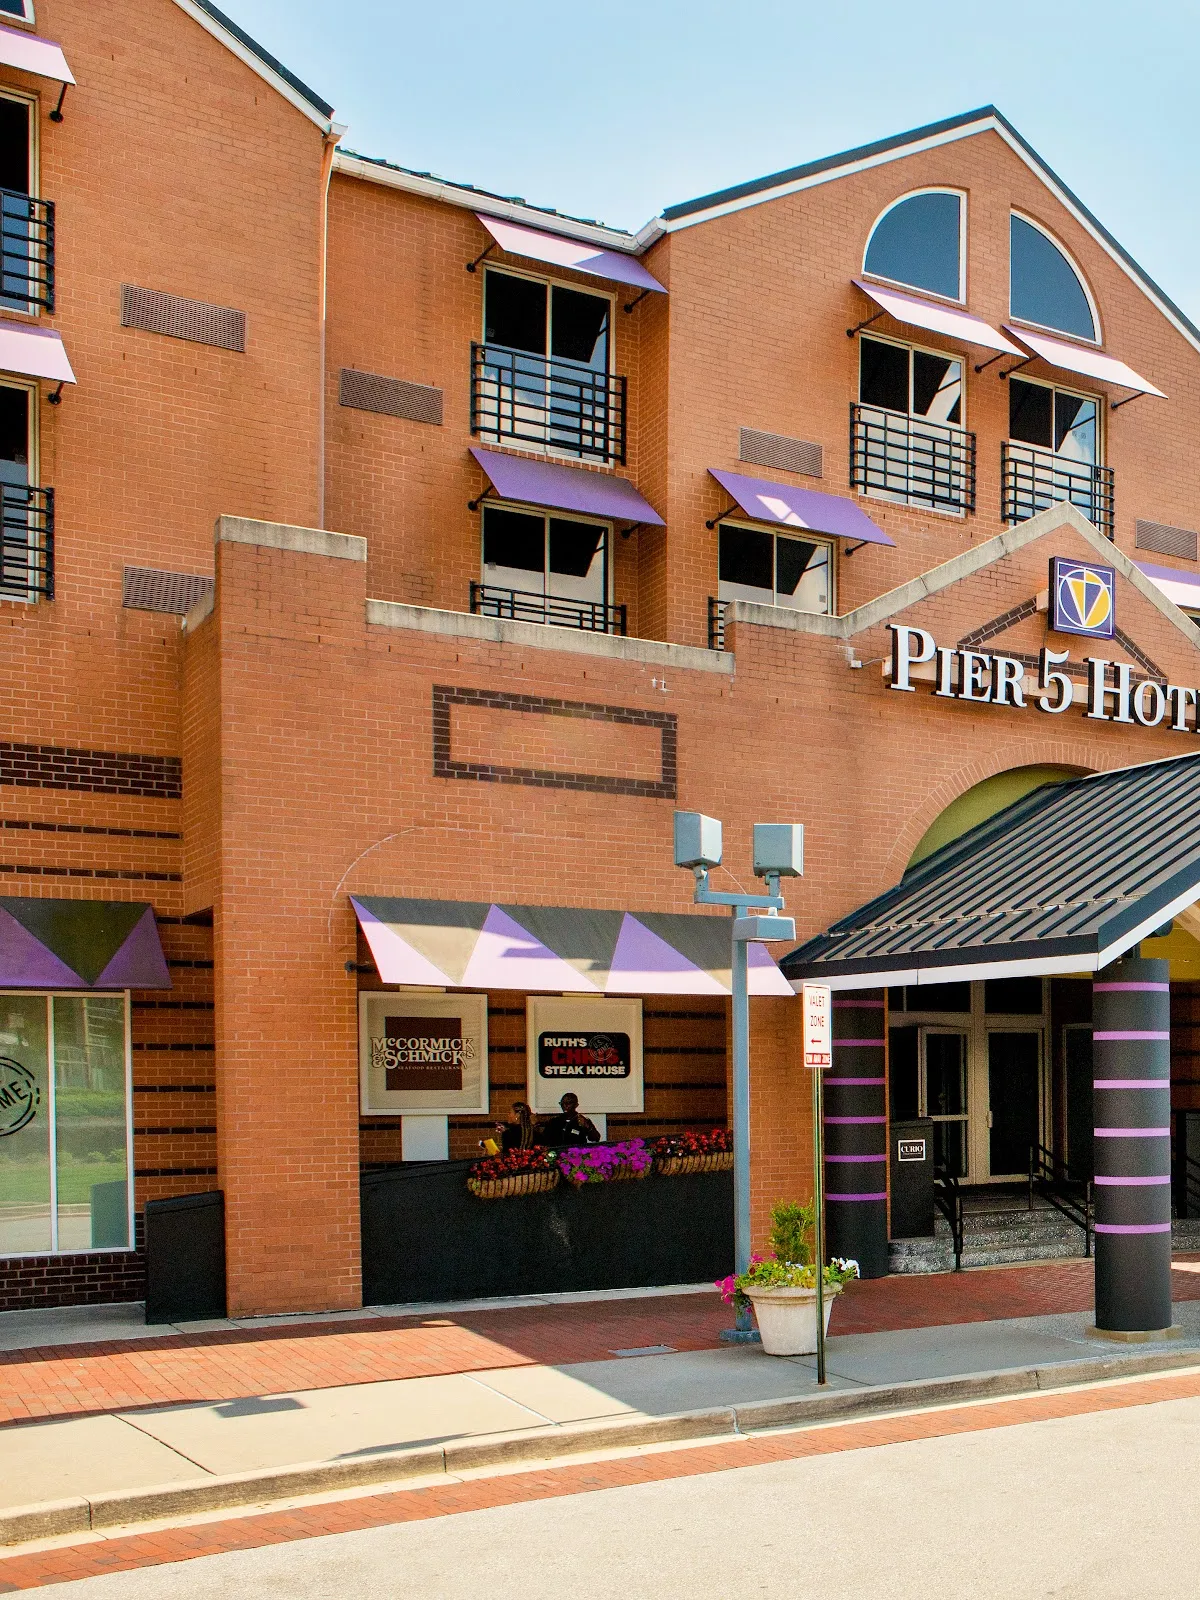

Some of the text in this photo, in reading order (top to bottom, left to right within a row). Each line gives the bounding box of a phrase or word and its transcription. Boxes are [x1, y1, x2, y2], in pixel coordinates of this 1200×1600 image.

[886, 624, 1027, 708] PIER
[1039, 647, 1074, 713] 5
[809, 995, 825, 1007] VALET
[810, 1015, 824, 1027] ZONE
[543, 1037, 588, 1047] RUTH'S
[544, 1065, 626, 1075] STEAK HOUSE
[900, 1145, 923, 1153] CURIO
